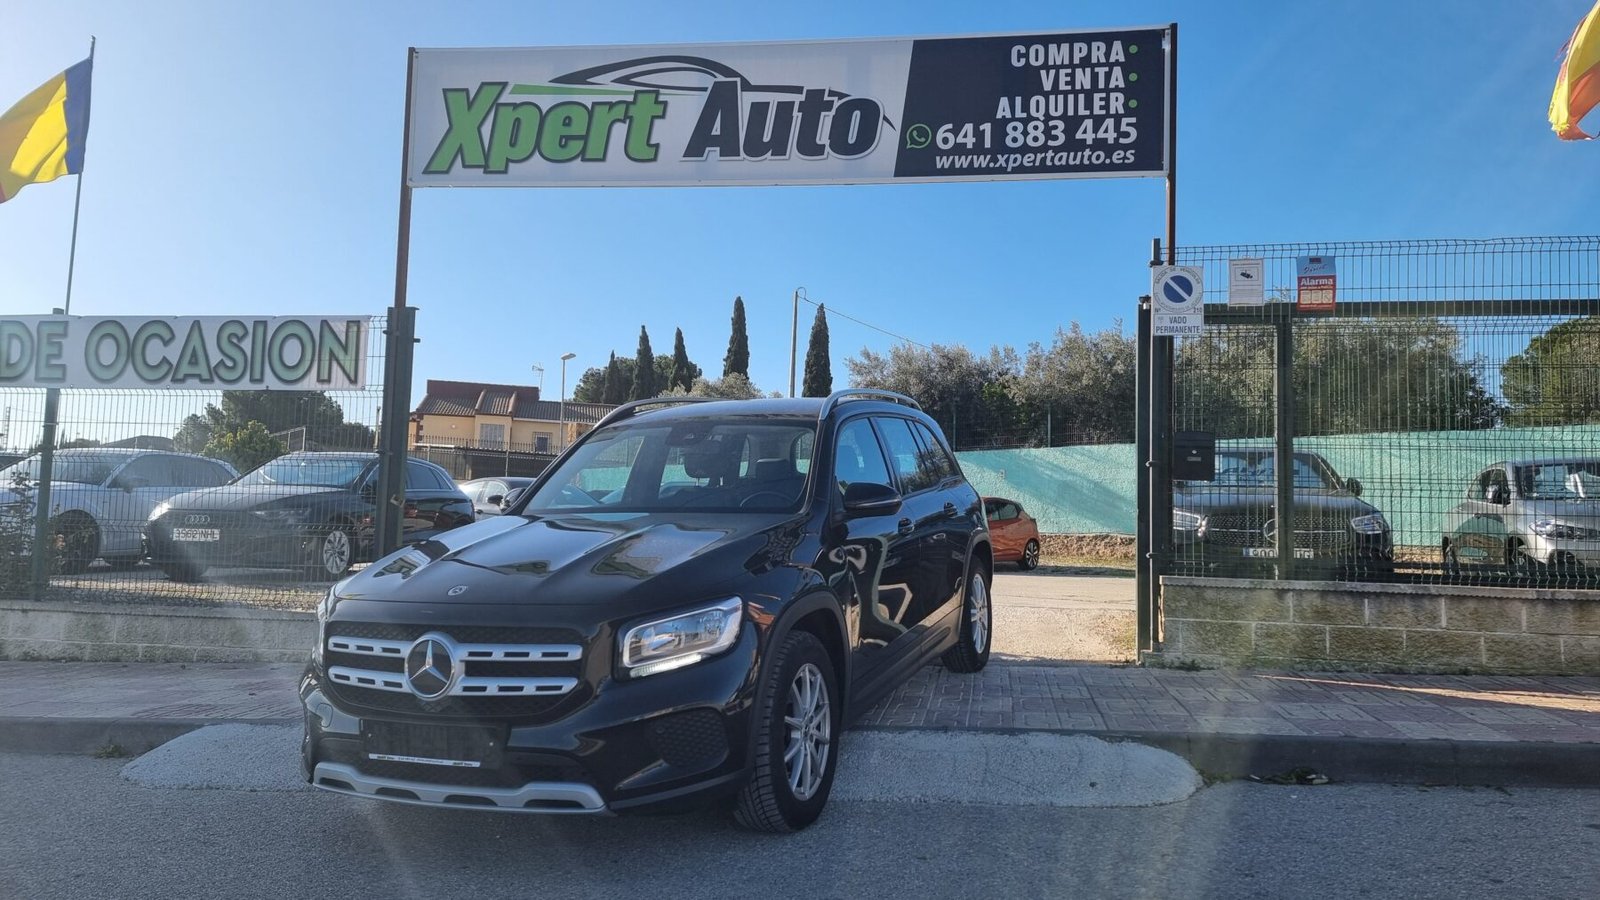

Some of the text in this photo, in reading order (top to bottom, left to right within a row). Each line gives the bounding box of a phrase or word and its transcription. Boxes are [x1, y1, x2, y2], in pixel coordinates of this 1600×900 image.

[1010, 40, 1126, 68] COMPRA
[1039, 66, 1126, 92] VENTA
[996, 92, 1125, 121] ALQUILER
[422, 78, 883, 175] Xpert Auto
[935, 117, 1138, 150] 641 883 445
[935, 149, 1136, 172] www.xpertauto.es
[1300, 278, 1334, 286] Alarma
[1155, 325, 1201, 334] PERMANENTE
[1169, 316, 1187, 324] VADO
[0, 319, 362, 385] DE OCASION
